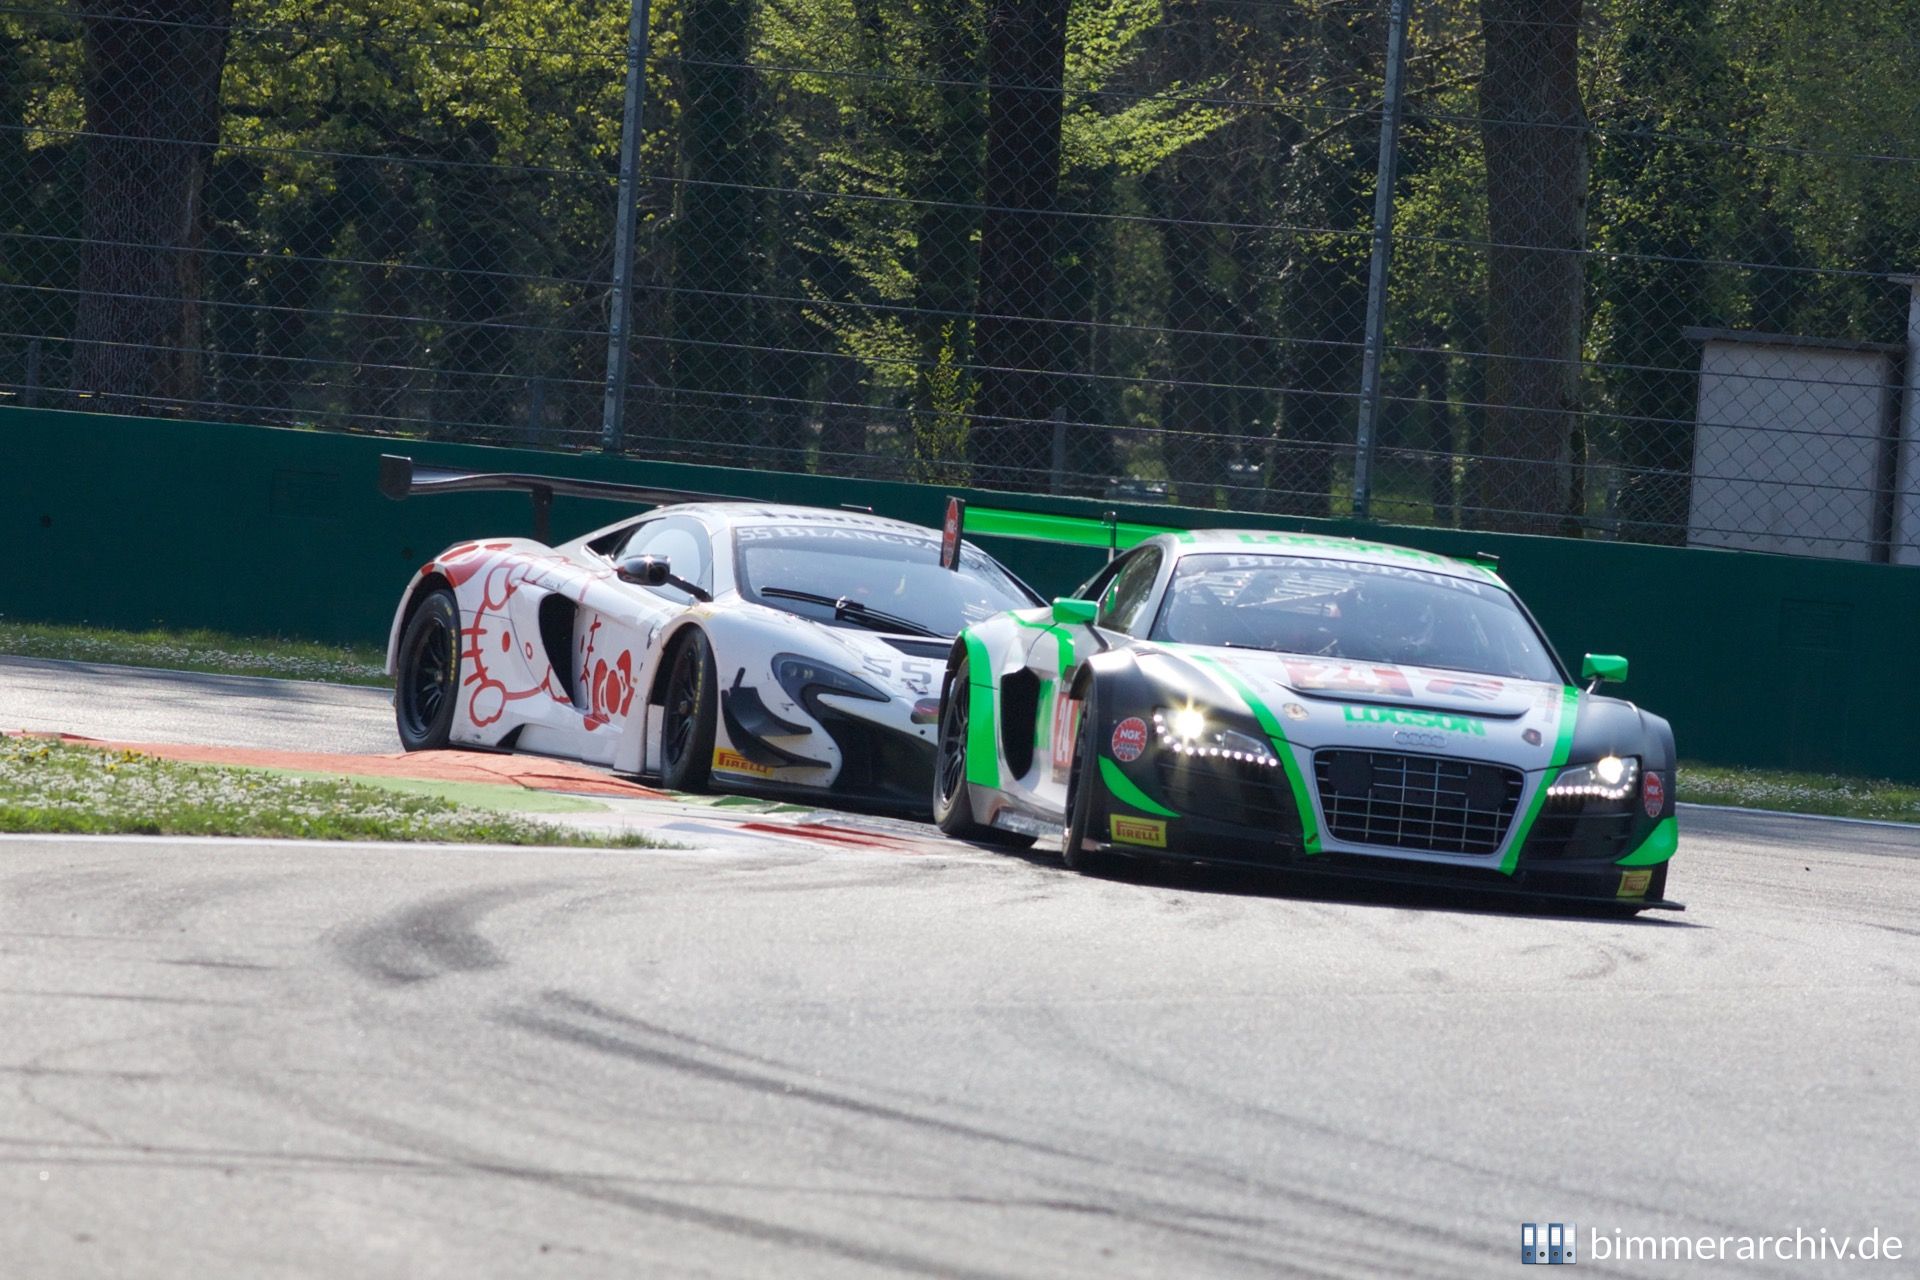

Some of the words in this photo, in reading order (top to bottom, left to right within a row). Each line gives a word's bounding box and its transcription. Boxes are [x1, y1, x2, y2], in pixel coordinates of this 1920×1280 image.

[735, 527, 772, 542] 55
[1227, 556, 1480, 596] BLANCPAIN
[862, 655, 932, 686] 55
[1342, 704, 1488, 738] LOGSON
[1120, 729, 1143, 741] NGK
[717, 751, 769, 774] PIRELLI
[1115, 820, 1160, 842] PIRELLI
